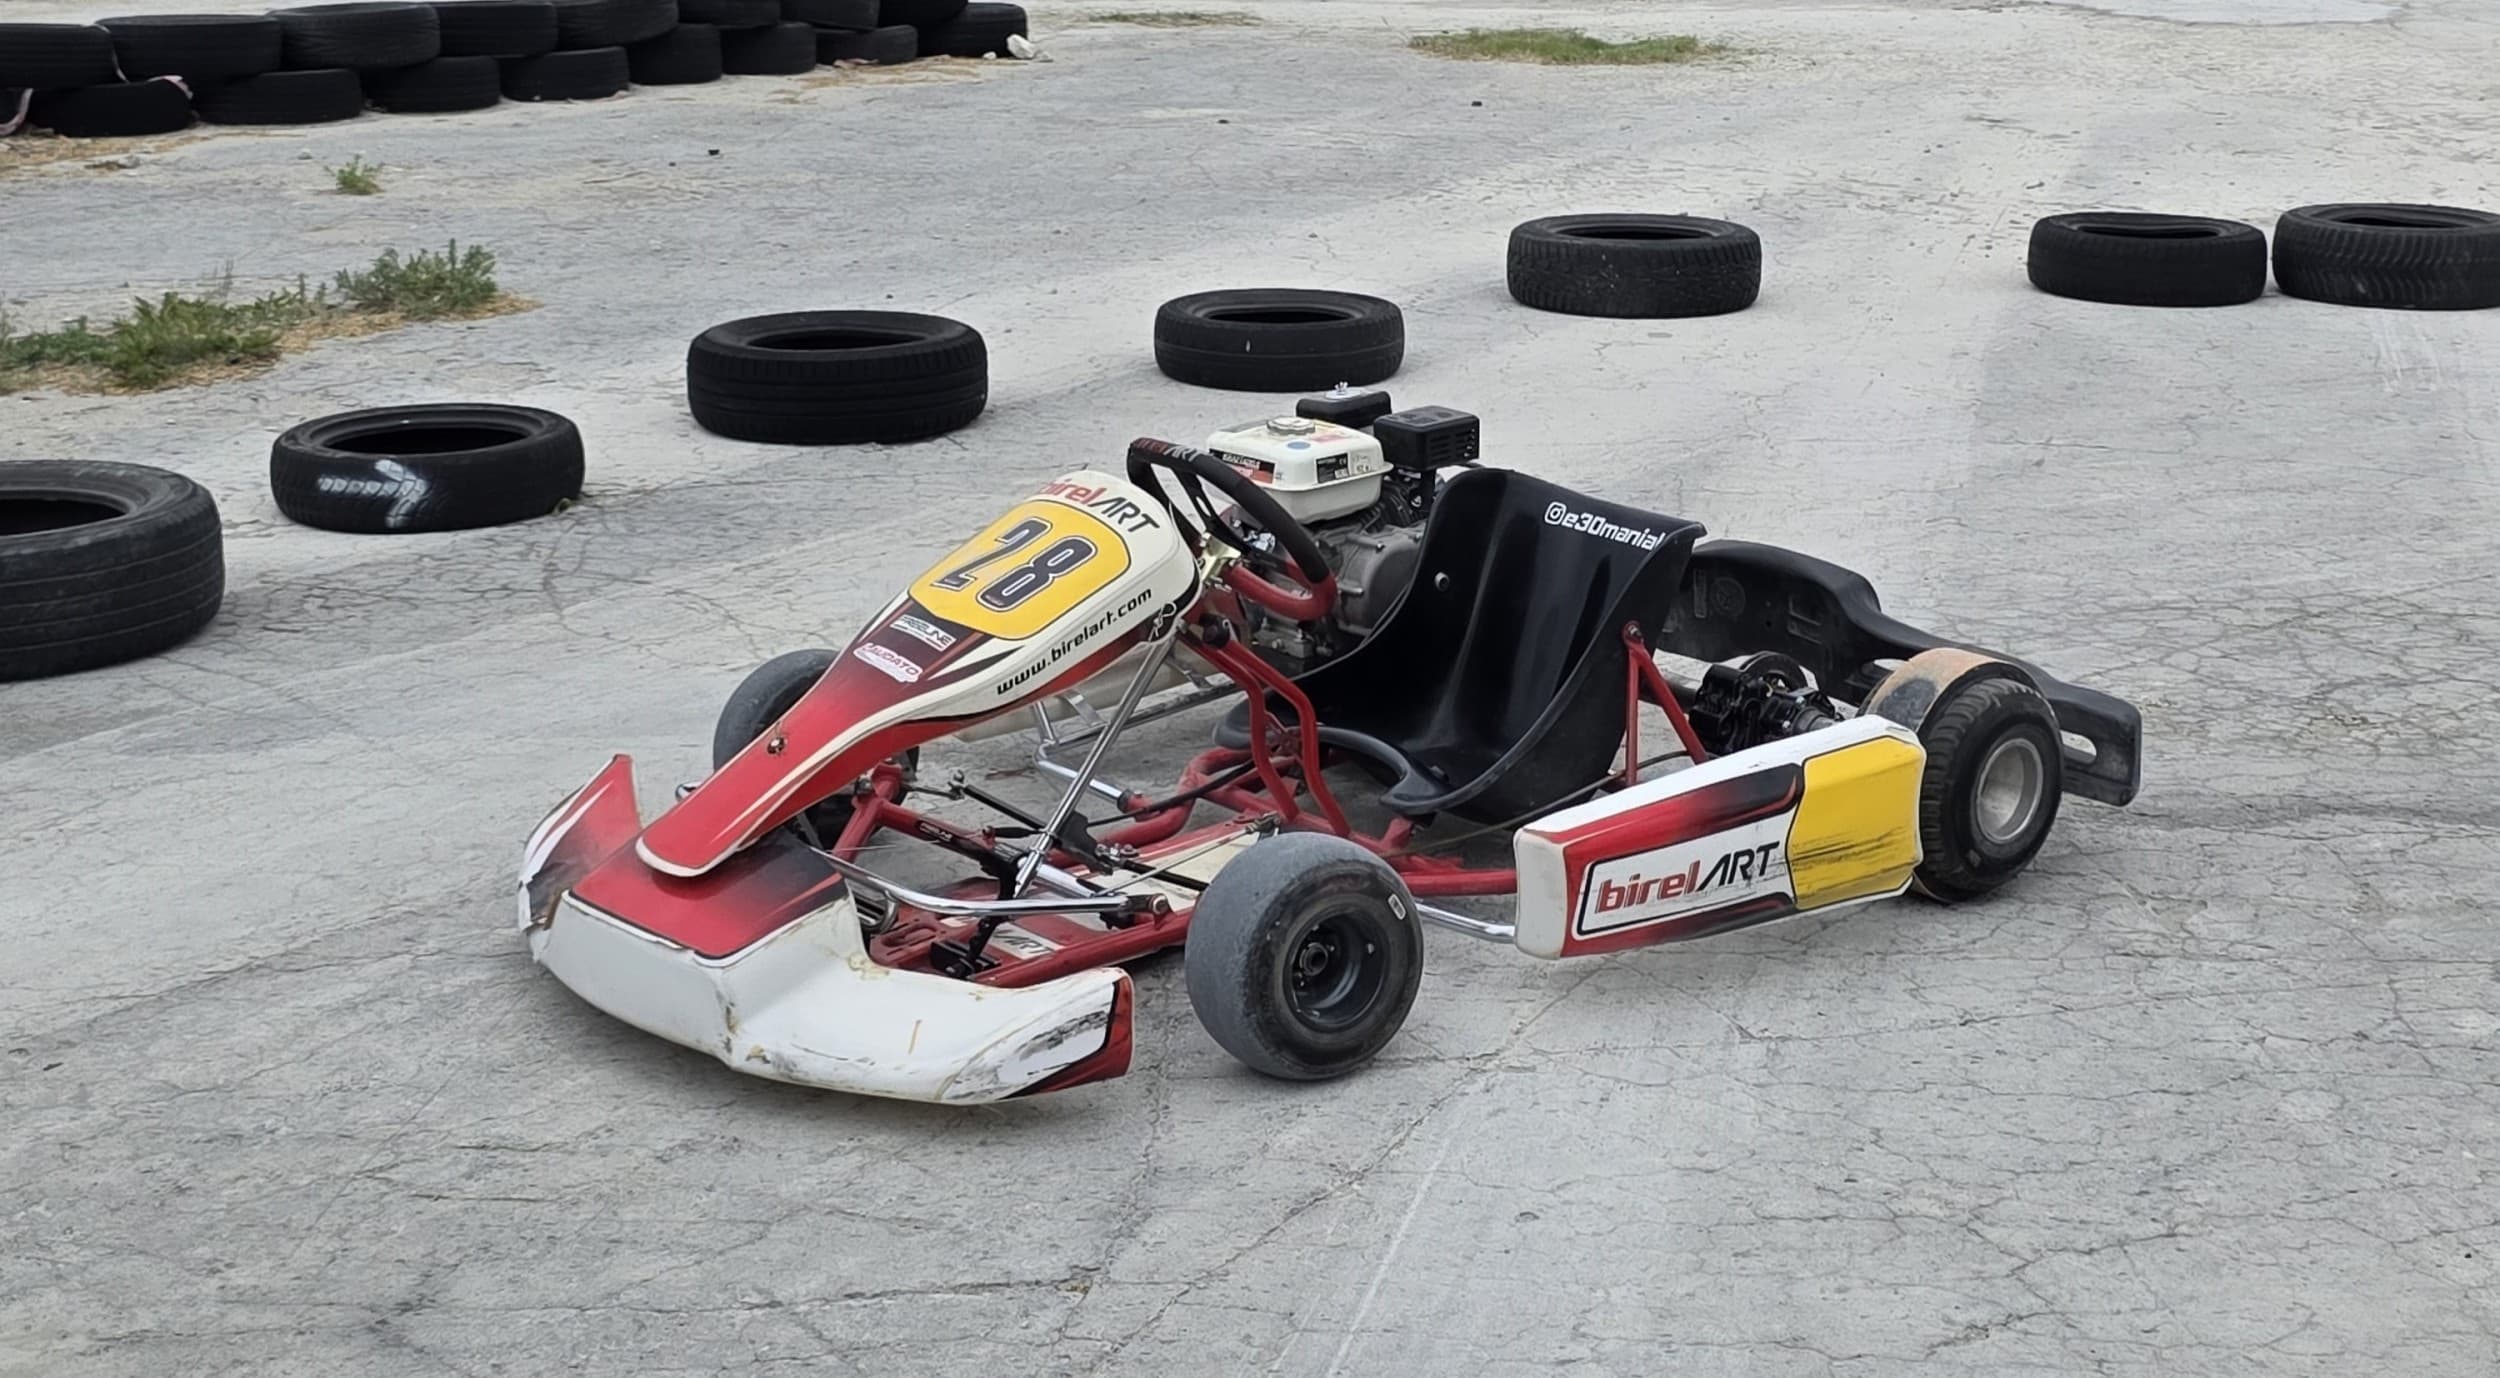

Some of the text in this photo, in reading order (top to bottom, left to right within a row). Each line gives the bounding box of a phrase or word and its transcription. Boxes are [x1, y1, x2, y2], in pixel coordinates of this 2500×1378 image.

[930, 516, 1098, 612] 28
[997, 588, 1152, 695] www.birelart.com
[1594, 840, 1780, 913] birelART
